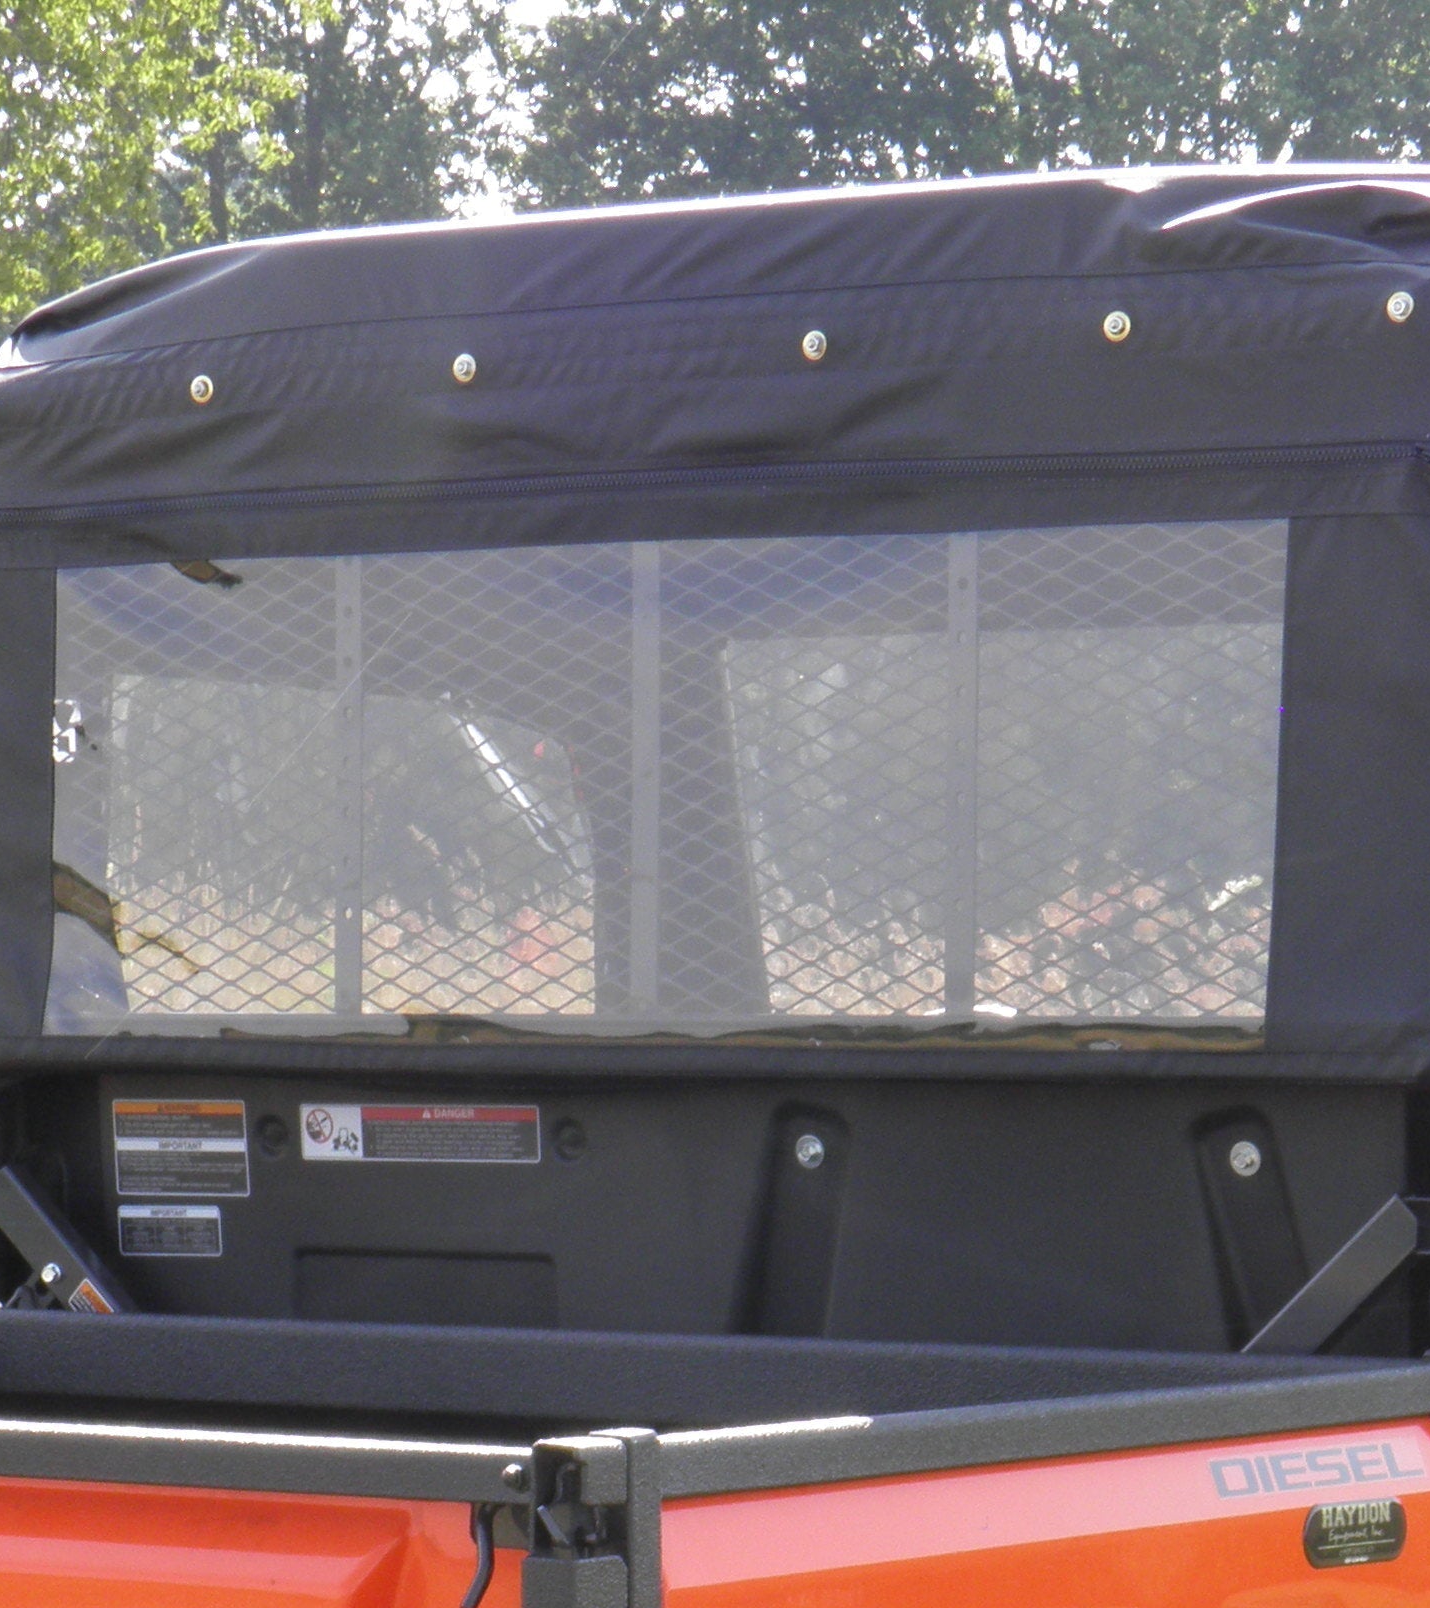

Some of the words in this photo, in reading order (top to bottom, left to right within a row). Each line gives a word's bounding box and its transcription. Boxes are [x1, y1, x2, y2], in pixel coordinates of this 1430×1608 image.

[434, 1108, 475, 1119] DANGER
[159, 1140, 202, 1150] IMPORTANT
[1210, 1442, 1424, 1499] DIESEL
[1321, 1501, 1391, 1529] HAYDON
